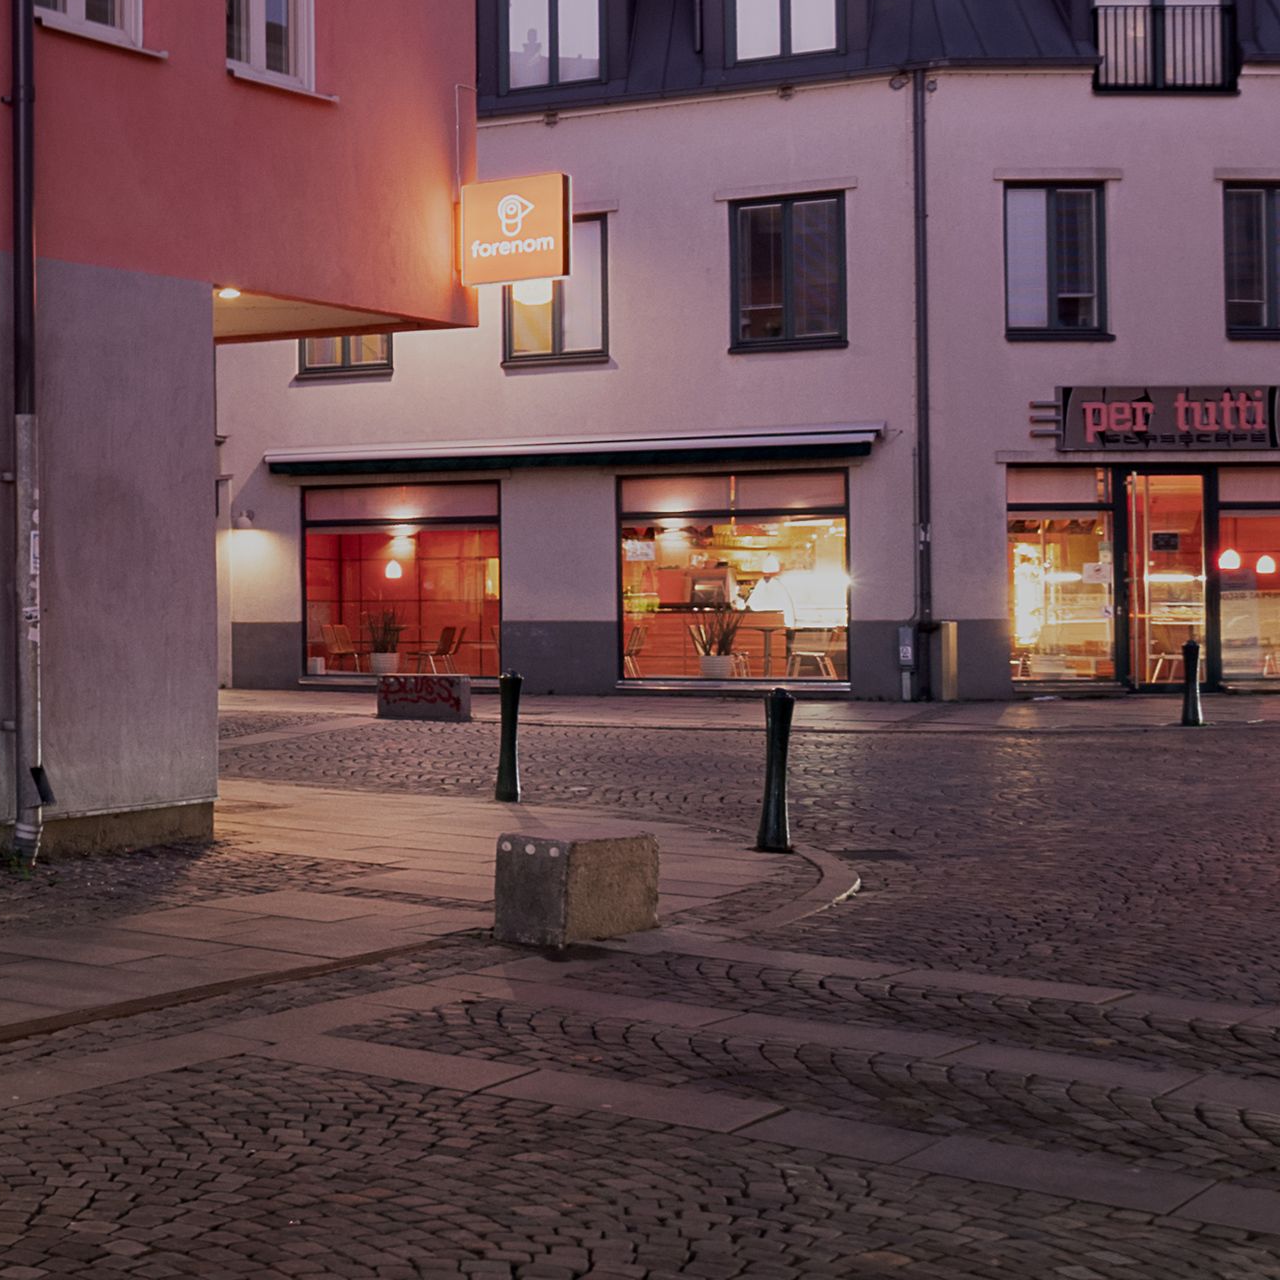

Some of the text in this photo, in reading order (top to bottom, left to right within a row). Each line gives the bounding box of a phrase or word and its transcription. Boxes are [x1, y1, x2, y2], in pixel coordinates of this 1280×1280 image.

[471, 236, 555, 258] forenom
[1082, 389, 1267, 444] per tutti
